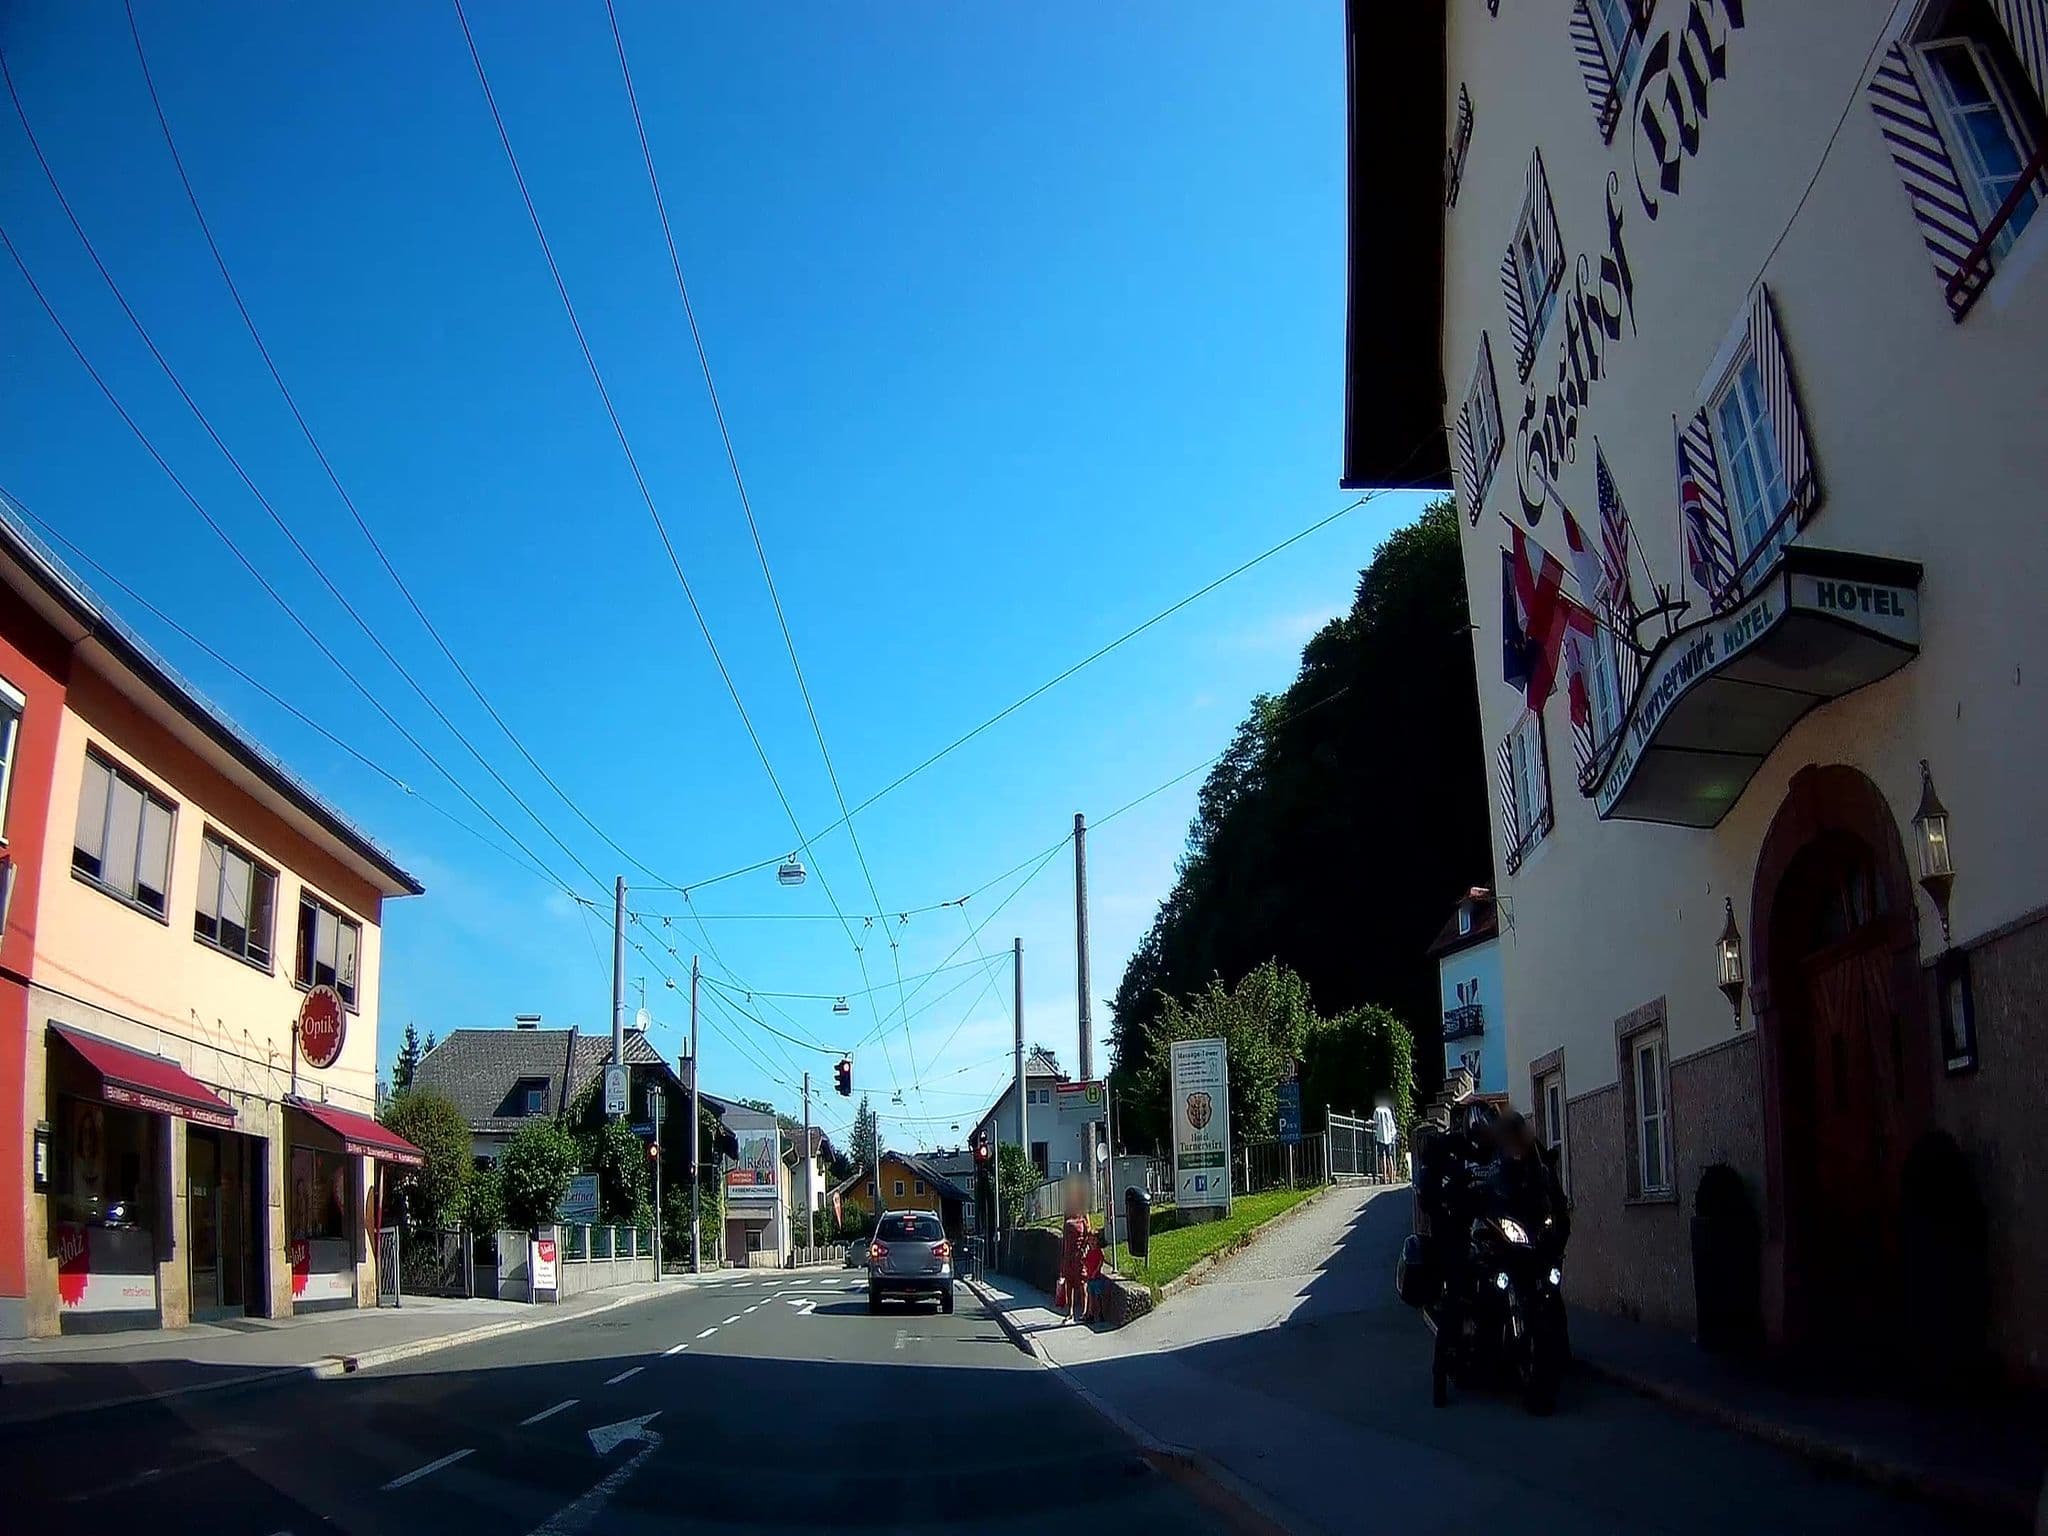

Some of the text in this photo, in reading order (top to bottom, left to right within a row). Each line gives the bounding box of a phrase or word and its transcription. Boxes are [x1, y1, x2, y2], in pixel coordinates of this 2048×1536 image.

[1516, 170, 1637, 528] Gasthof
[1817, 582, 1905, 617] HOTEL
[1602, 600, 1774, 806] HOTEL Turnerwirt HOTEL
[304, 1015, 334, 1040] Optik
